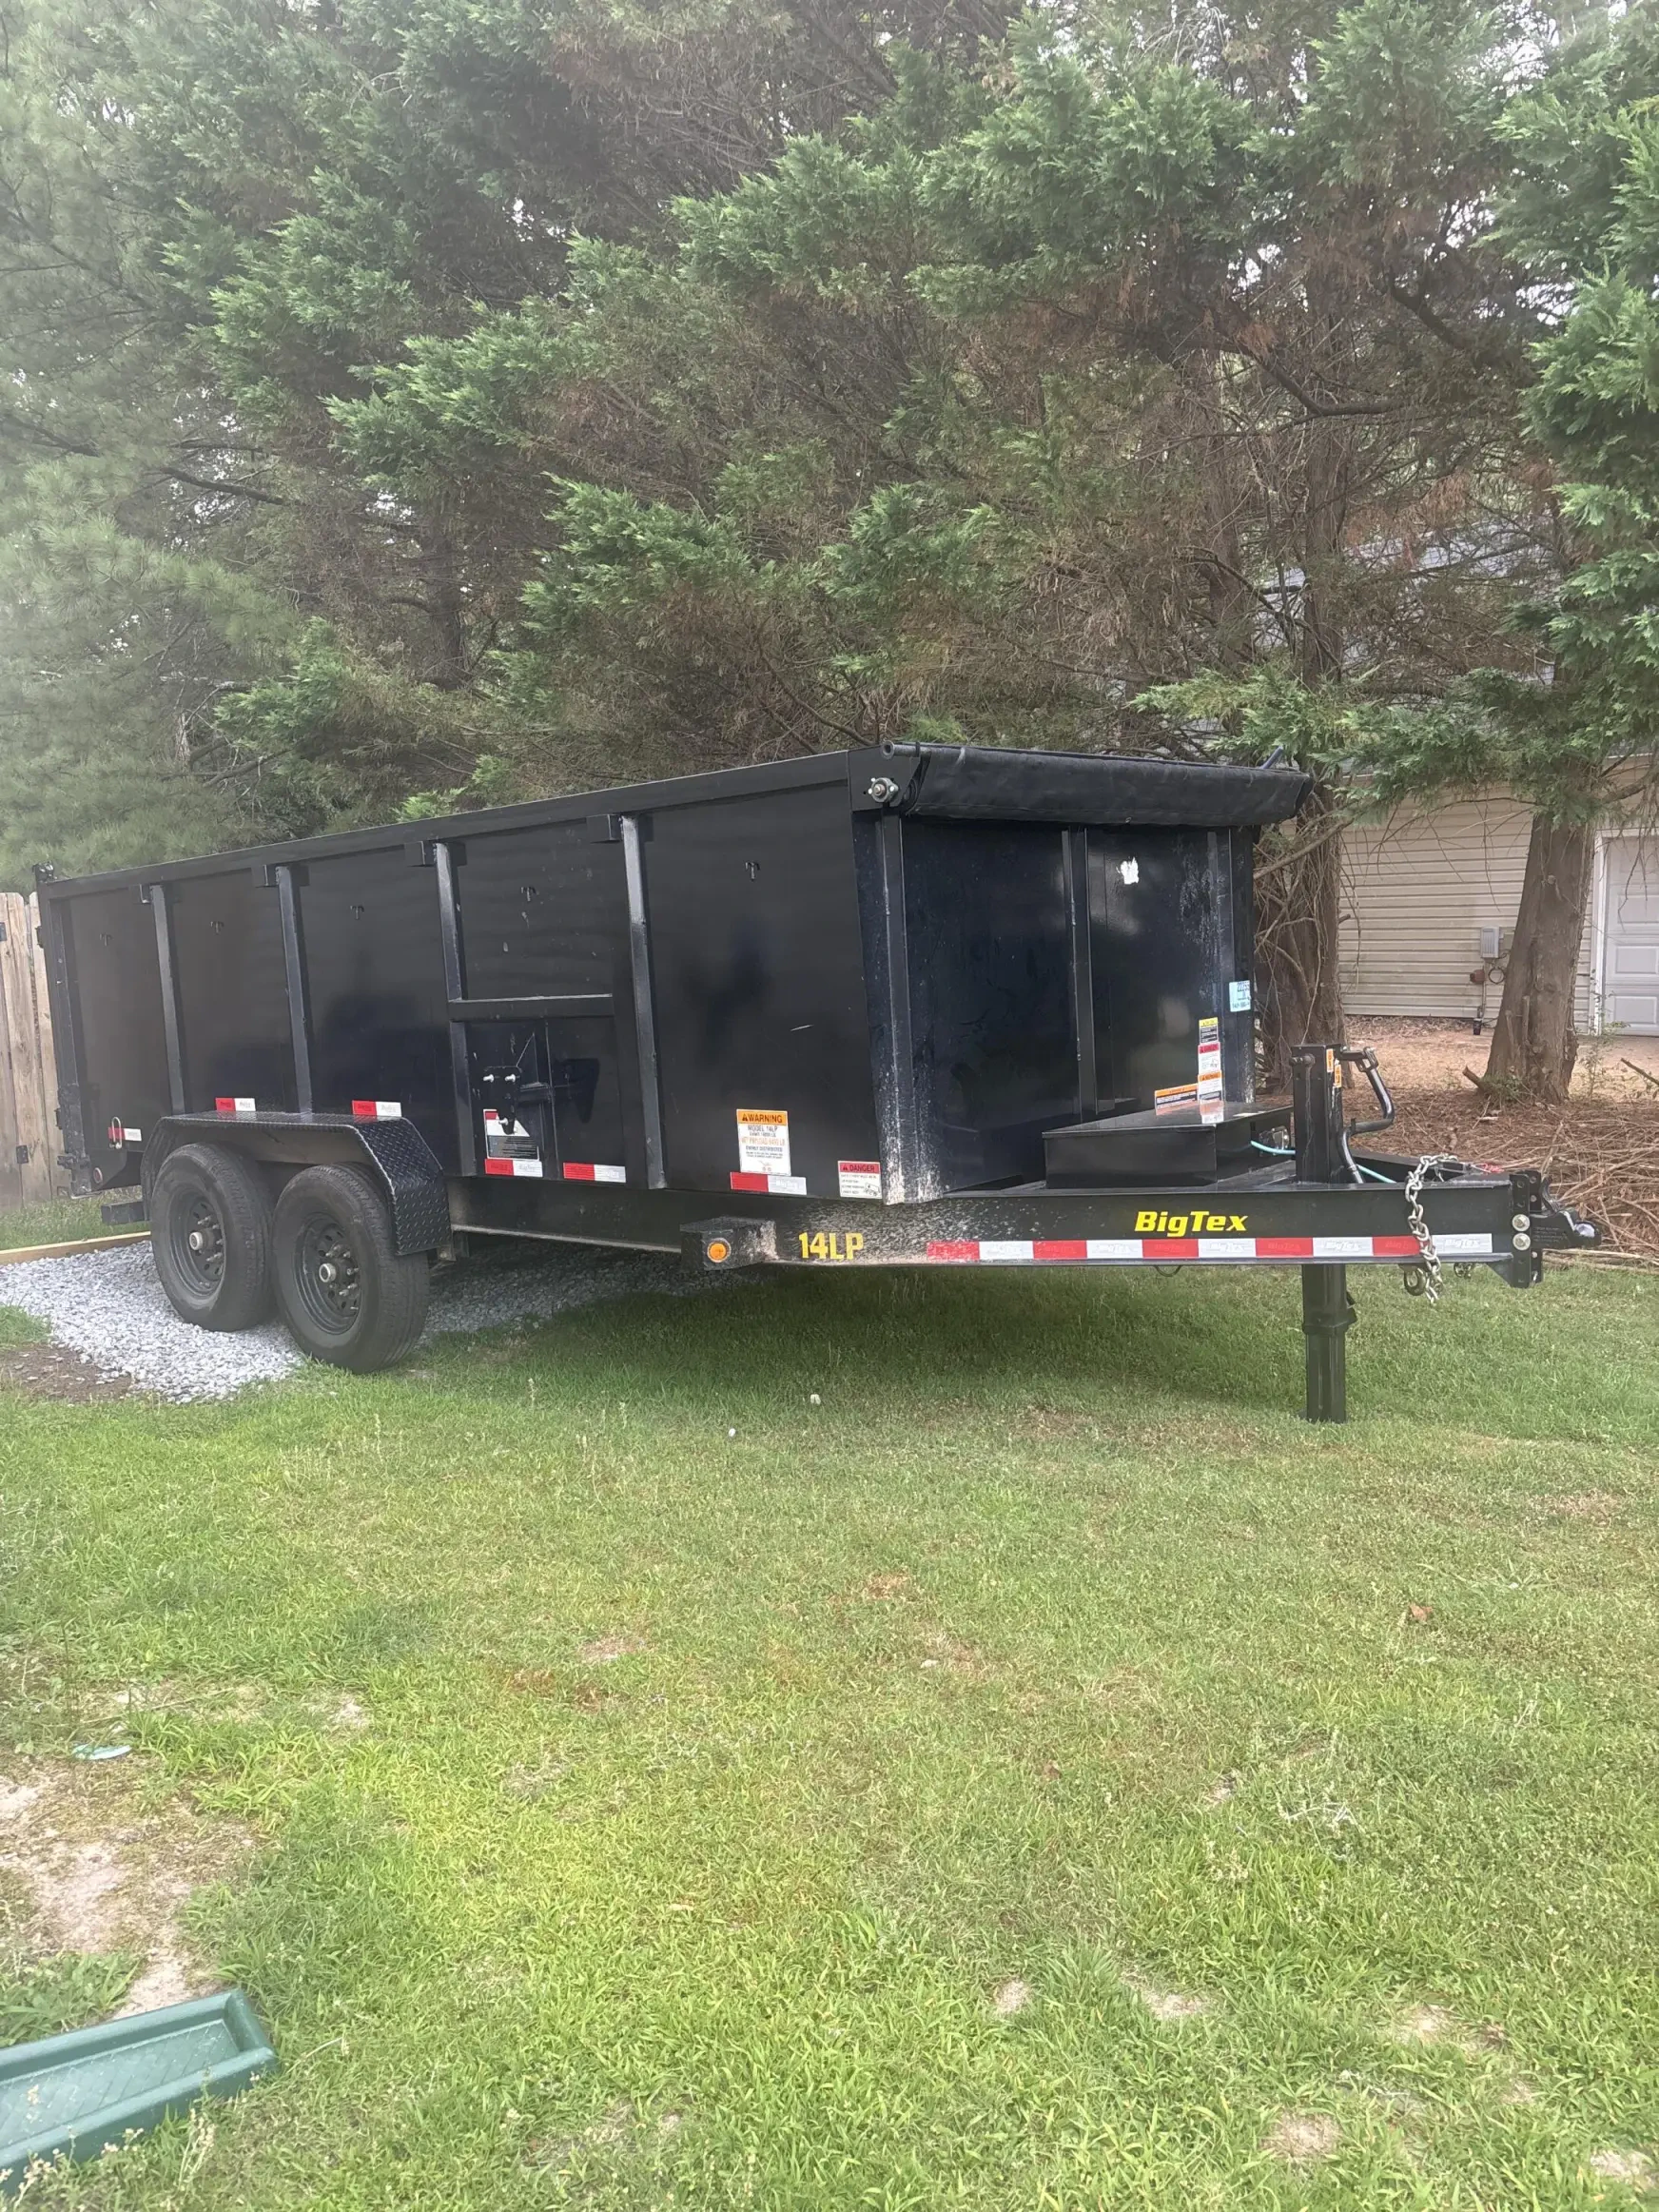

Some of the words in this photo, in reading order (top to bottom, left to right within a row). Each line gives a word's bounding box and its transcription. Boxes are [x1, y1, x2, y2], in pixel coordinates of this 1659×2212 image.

[749, 1113, 783, 1124] WARNING
[849, 1164, 875, 1172] DANGER
[1134, 1211, 1248, 1237] BigTex
[799, 1231, 864, 1260] 14LP
